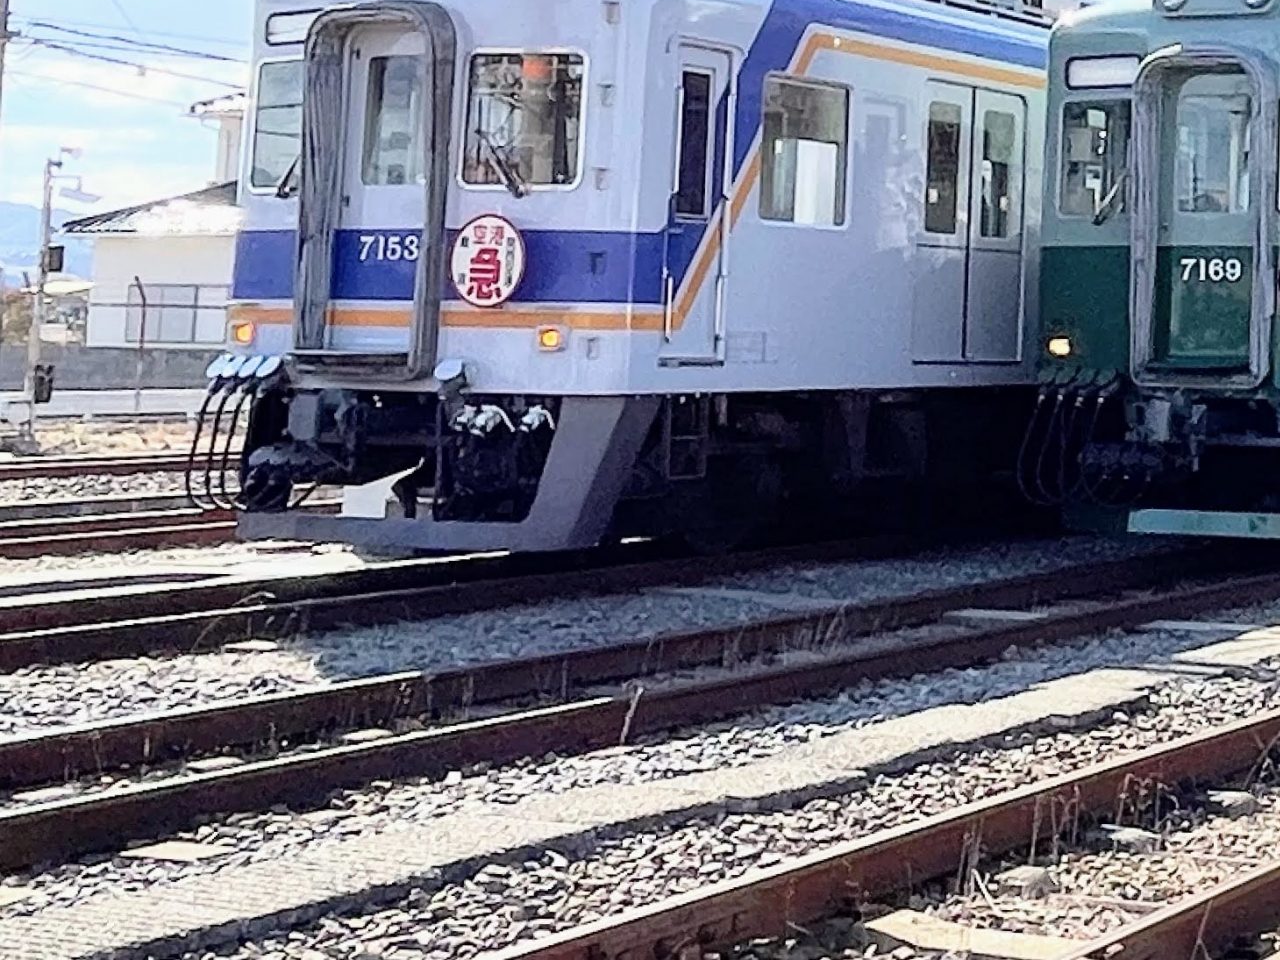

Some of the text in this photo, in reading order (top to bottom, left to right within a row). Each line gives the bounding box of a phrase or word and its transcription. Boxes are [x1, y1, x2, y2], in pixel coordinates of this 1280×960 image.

[359, 235, 419, 261] 7153
[467, 248, 502, 299] 急
[1180, 258, 1242, 281] 7169
